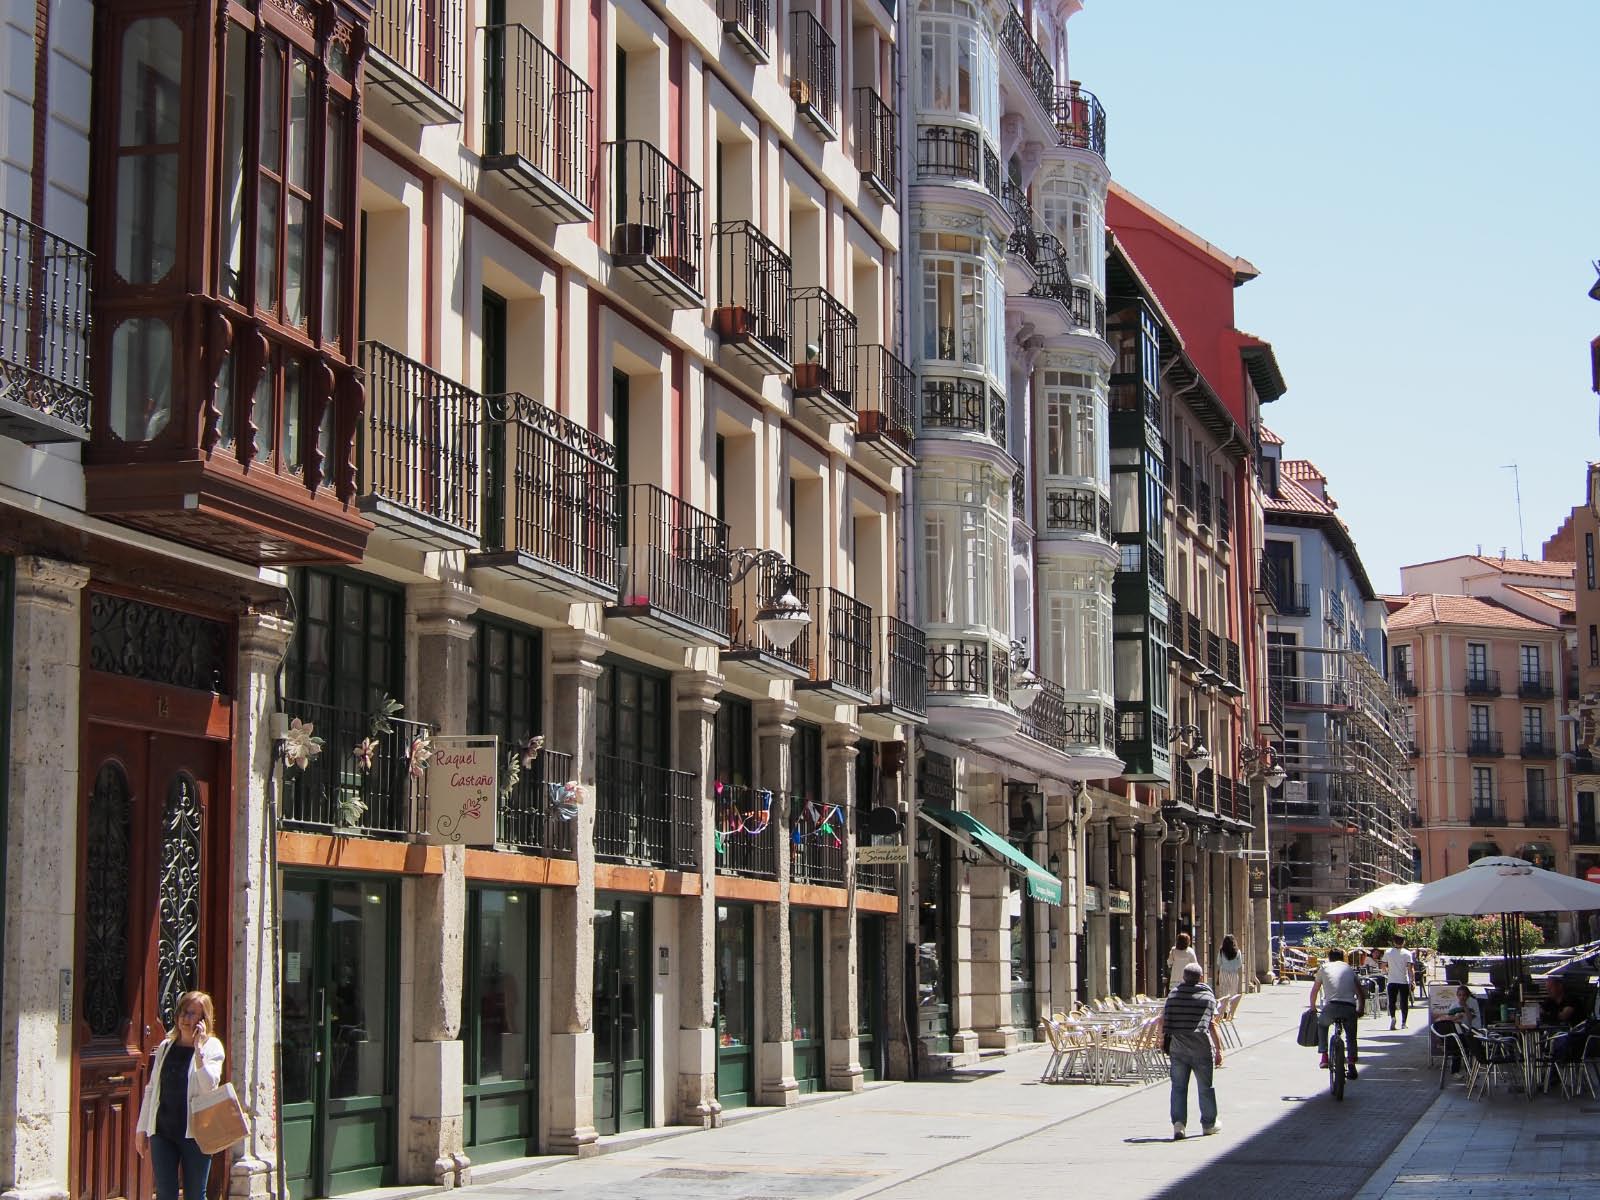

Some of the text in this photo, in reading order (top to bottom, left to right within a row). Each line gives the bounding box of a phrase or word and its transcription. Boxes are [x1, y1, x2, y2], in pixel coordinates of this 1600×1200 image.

[435, 750, 477, 769] Raquel
[451, 773, 493, 787] Castaño
[866, 850, 906, 862] Sombrero
